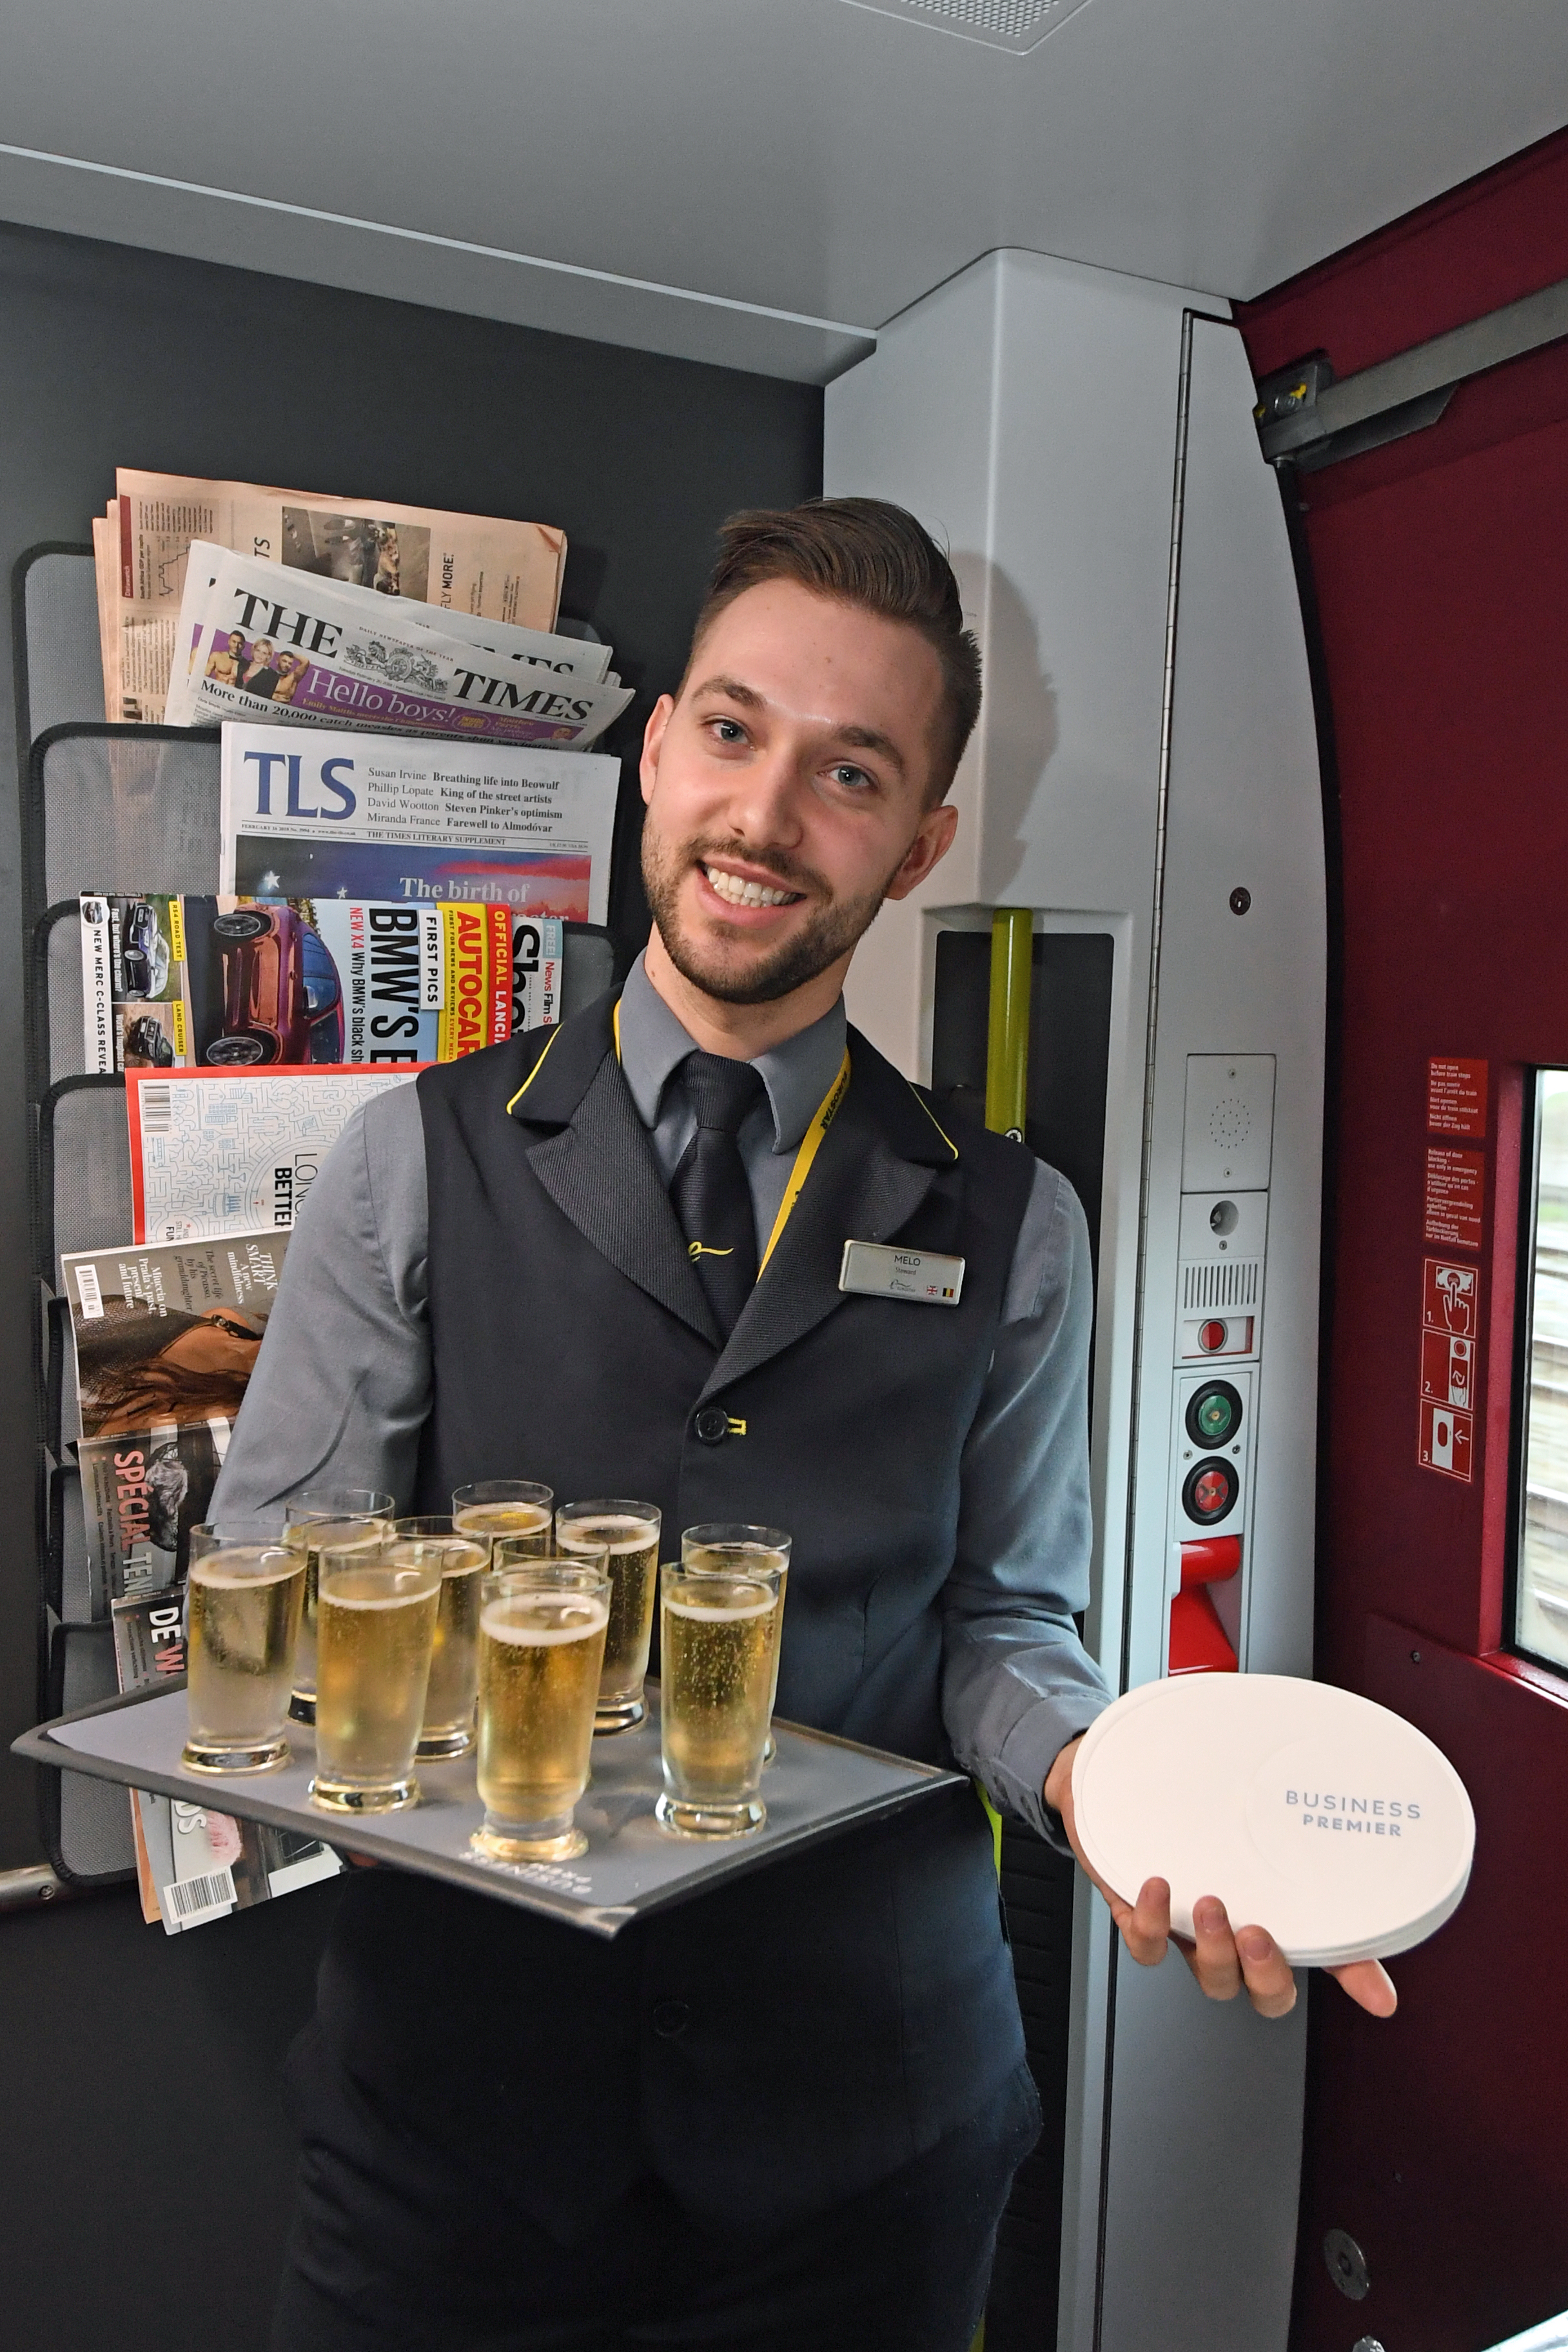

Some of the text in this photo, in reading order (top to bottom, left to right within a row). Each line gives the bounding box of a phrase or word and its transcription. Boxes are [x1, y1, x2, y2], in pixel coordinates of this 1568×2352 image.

[253, 536, 270, 558] TS
[233, 587, 344, 659] THE
[453, 667, 594, 721] TIMES
[201, 680, 235, 702] More
[239, 695, 268, 712] than
[272, 705, 317, 721] 20,000
[320, 713, 353, 727] catch
[306, 667, 383, 710] Hello
[387, 694, 456, 722] boys!
[244, 750, 357, 820] TLS
[368, 767, 560, 790] Susan Irvine Breathing life into Beowulf
[368, 782, 552, 804] Phillip Lopate King of the street artists
[367, 812, 553, 832] Miranda France Farewell to Almodóvar
[368, 797, 562, 819] David Wootton Steven Pinker's optimism
[386, 831, 411, 840] TIMES
[413, 833, 453, 843] LITERARY
[455, 835, 505, 845] SUPPLEMENT
[399, 877, 530, 903] The birth of
[426, 917, 438, 1003] FIRST PICS
[494, 910, 508, 985] OFFICIAL
[349, 907, 366, 1064] NEW X4 Why BMW's black sh
[369, 908, 419, 1038] BMW'S
[456, 910, 483, 1059] AUTOCAR
[512, 925, 540, 1033] Sho
[543, 961, 555, 1024] News Film S
[93, 930, 106, 1073] NEW MERC C-CLASS REVEA
[127, 1266, 144, 1298] present
[205, 1250, 224, 1299] The secret life
[227, 1251, 245, 1304] mindfulness
[242, 1272, 253, 1291] new
[246, 1243, 267, 1286] SMART
[259, 1252, 279, 1291] THINK
[894, 1255, 921, 1266] MELO
[118, 1263, 135, 1309] and future
[139, 1257, 157, 1315] Prada's past,
[151, 1266, 168, 1317] Miuccia on
[1427, 1310, 1434, 1323] 1.
[1424, 1380, 1433, 1393] 2.
[1422, 1450, 1431, 1464] 3.
[113, 1450, 154, 1551] SPÉCIAL
[149, 1606, 181, 1643] DE
[154, 1643, 185, 1679] W
[1286, 1790, 1421, 1819] BUSINESS
[1302, 1814, 1402, 1837] PREMIER
